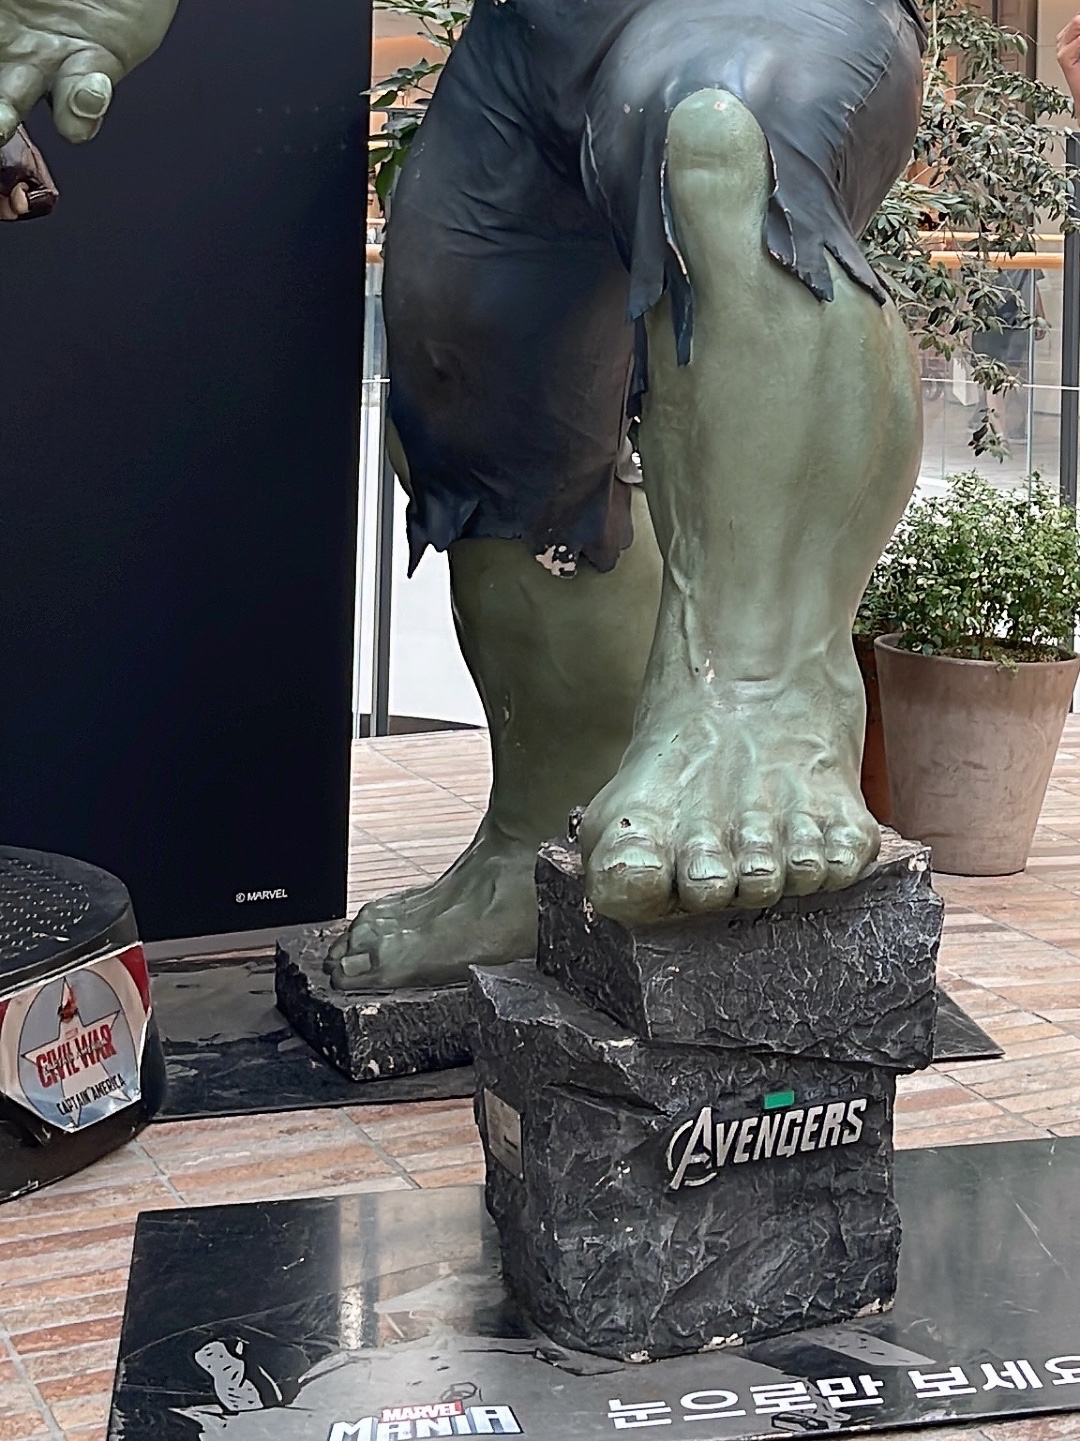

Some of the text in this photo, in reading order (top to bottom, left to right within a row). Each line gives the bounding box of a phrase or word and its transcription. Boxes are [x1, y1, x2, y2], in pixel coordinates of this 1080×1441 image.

[36, 1024, 117, 1088] CIVIL WAR
[56, 1073, 126, 1116] CAPTAIN AMERICA
[327, 1405, 524, 1441] MANIA
[381, 1402, 462, 1422] MARVEL
[607, 1374, 884, 1430] 눈으로만
